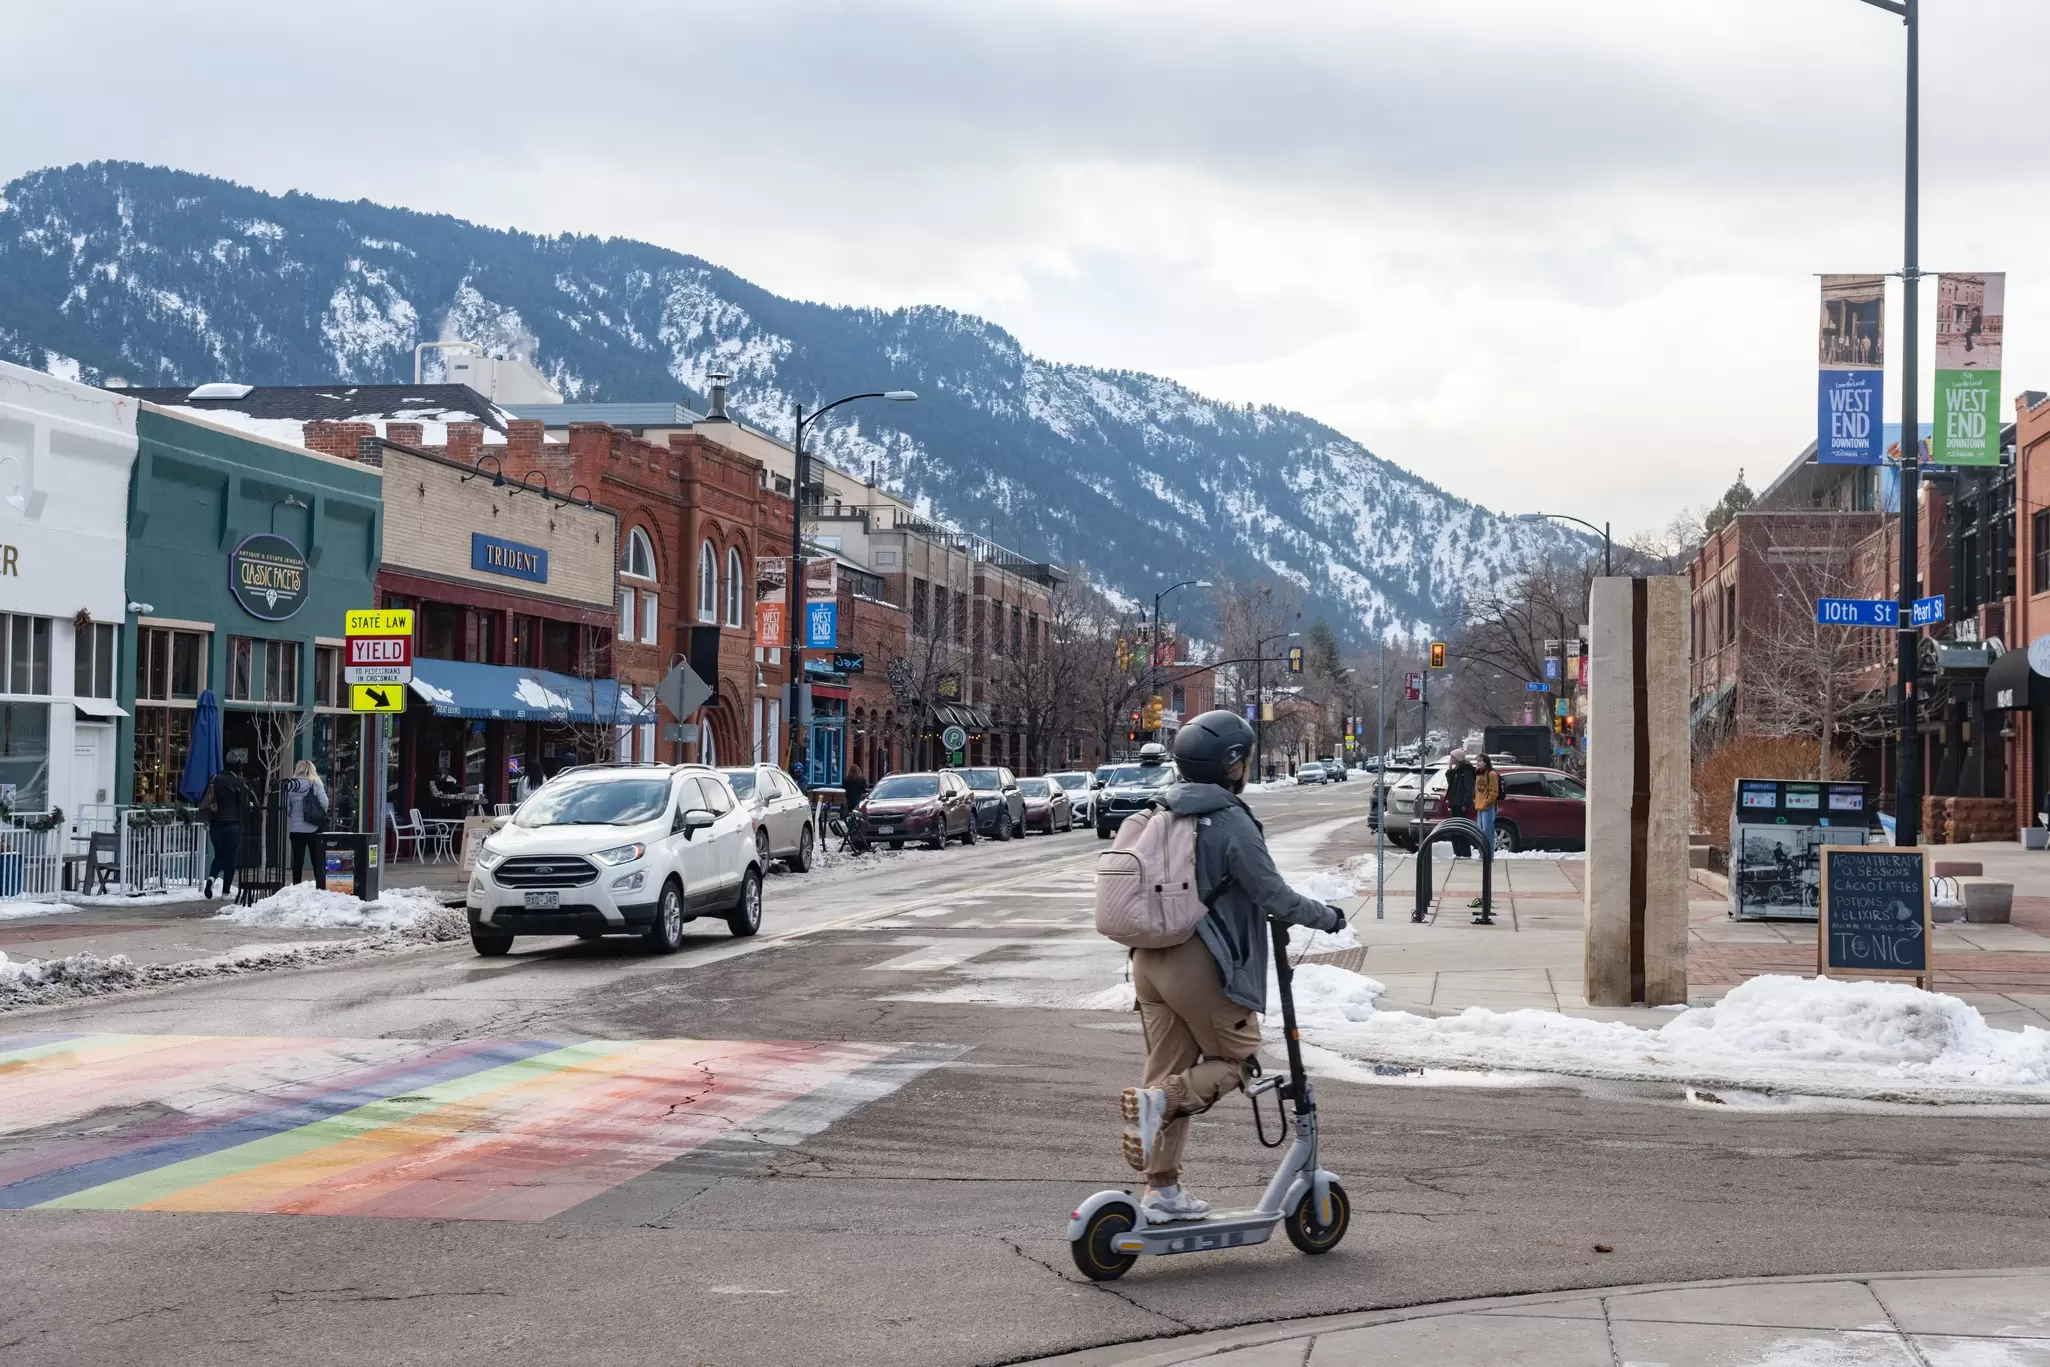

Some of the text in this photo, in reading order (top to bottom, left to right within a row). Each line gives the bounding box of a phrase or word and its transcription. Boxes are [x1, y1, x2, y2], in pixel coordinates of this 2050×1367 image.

[1829, 389, 1872, 412] WEST
[1945, 388, 1989, 412] WEST
[1832, 412, 1870, 438] END
[1947, 412, 1986, 438] END
[1832, 438, 1869, 448] DOWNTOWN
[1947, 438, 1985, 449] DOWNTOWN
[239, 550, 260, 559] ANTIQUE
[266, 554, 283, 562] ESTATE
[284, 558, 304, 566] JEWELRY
[486, 544, 538, 573] TRIDENT
[241, 563, 301, 591] CLASSIC FACETS
[763, 611, 780, 623] WEST
[811, 611, 832, 623] WEST
[1825, 602, 1891, 622] 10th St
[1913, 599, 1942, 622] Pearl St
[352, 617, 406, 628] STATE LAW
[763, 623, 779, 636] END
[812, 623, 831, 636] END
[355, 642, 402, 660] YIELD
[950, 732, 959, 743] P
[1833, 854, 1921, 868] AROMATHERAPY
[1857, 866, 1910, 877] SESSIONS
[1834, 879, 1919, 893] CACAO LATTES
[1836, 896, 1883, 908] POTIONS
[1841, 909, 1891, 921] ELIXIRS
[1833, 932, 1913, 965] TONIC
